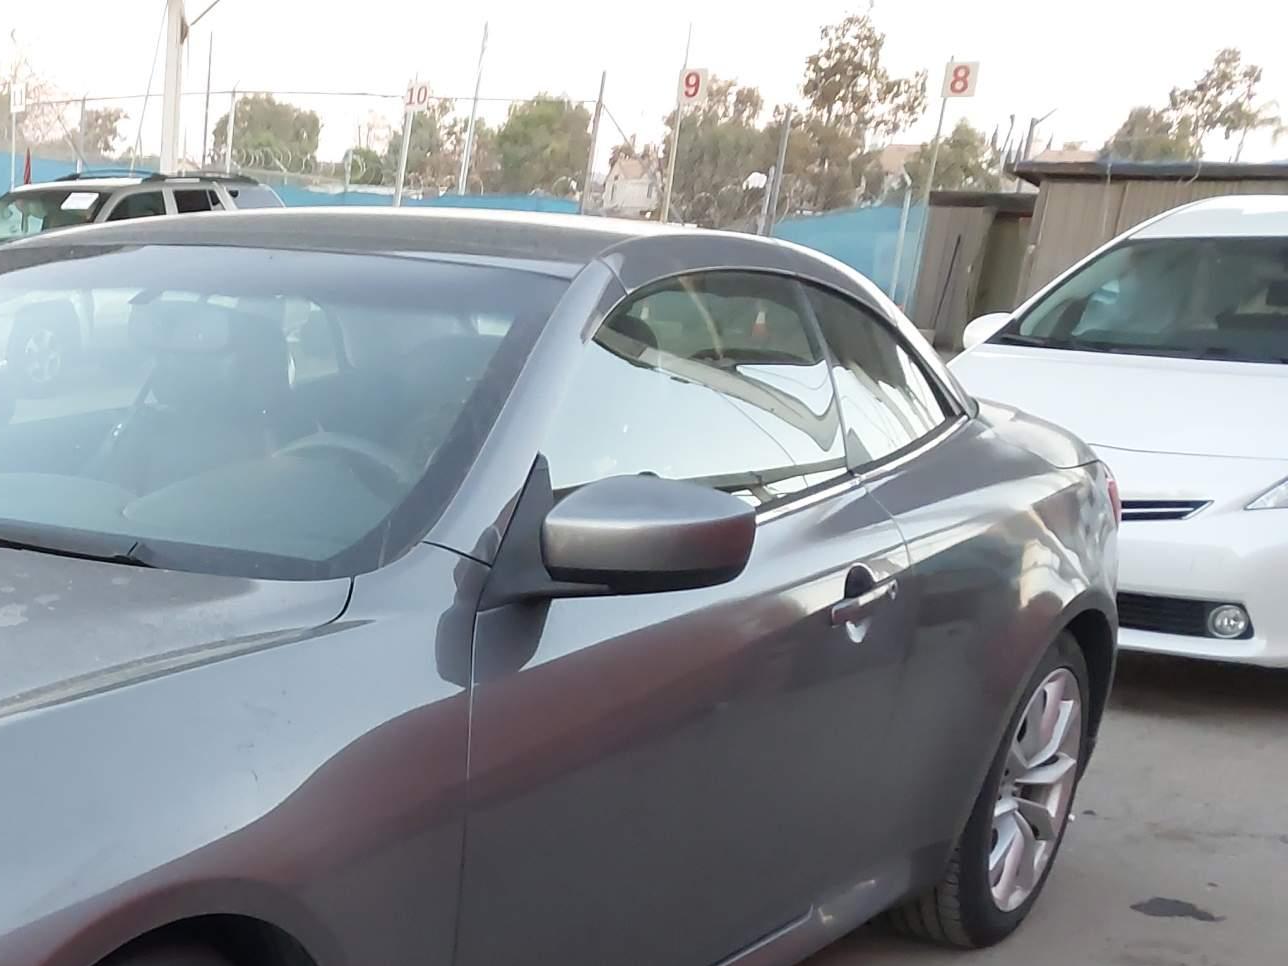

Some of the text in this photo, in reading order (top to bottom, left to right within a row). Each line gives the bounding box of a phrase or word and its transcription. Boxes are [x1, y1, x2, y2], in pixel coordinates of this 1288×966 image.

[684, 71, 701, 98] 9
[949, 64, 971, 94] 8
[405, 85, 428, 106] 10
